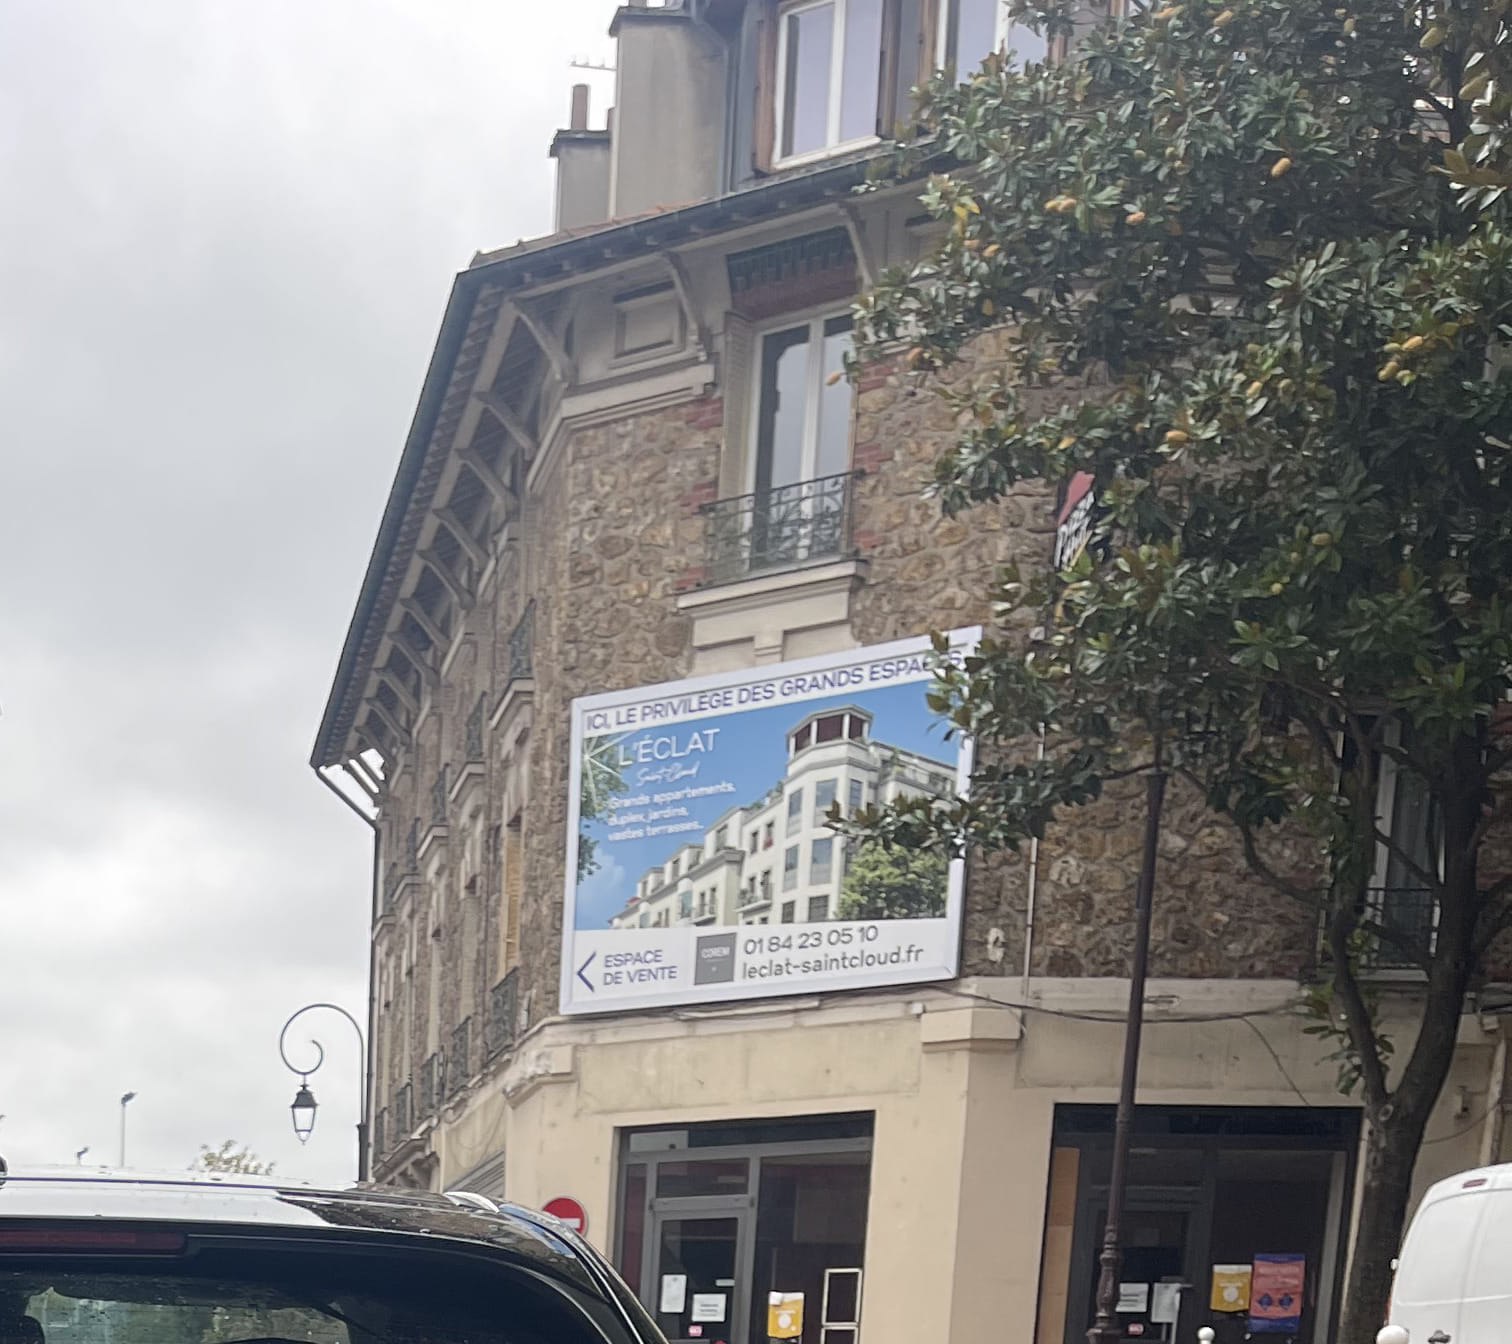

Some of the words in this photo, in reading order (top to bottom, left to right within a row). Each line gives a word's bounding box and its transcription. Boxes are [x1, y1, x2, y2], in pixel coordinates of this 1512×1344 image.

[587, 712, 611, 731] ICI,
[616, 708, 637, 726] LE
[738, 683, 775, 704] DES
[780, 667, 863, 697] GRANDS
[619, 727, 721, 766] L'ÉCLAT
[744, 937, 764, 955] 01
[768, 935, 792, 953] 84
[798, 931, 823, 950] 23
[828, 928, 853, 946] 05
[858, 924, 879, 942] 10
[604, 949, 663, 968] ESPACE
[742, 944, 925, 979] leclat-saintcloud.fr
[603, 971, 623, 986] DE
[627, 965, 678, 983] VENTE
